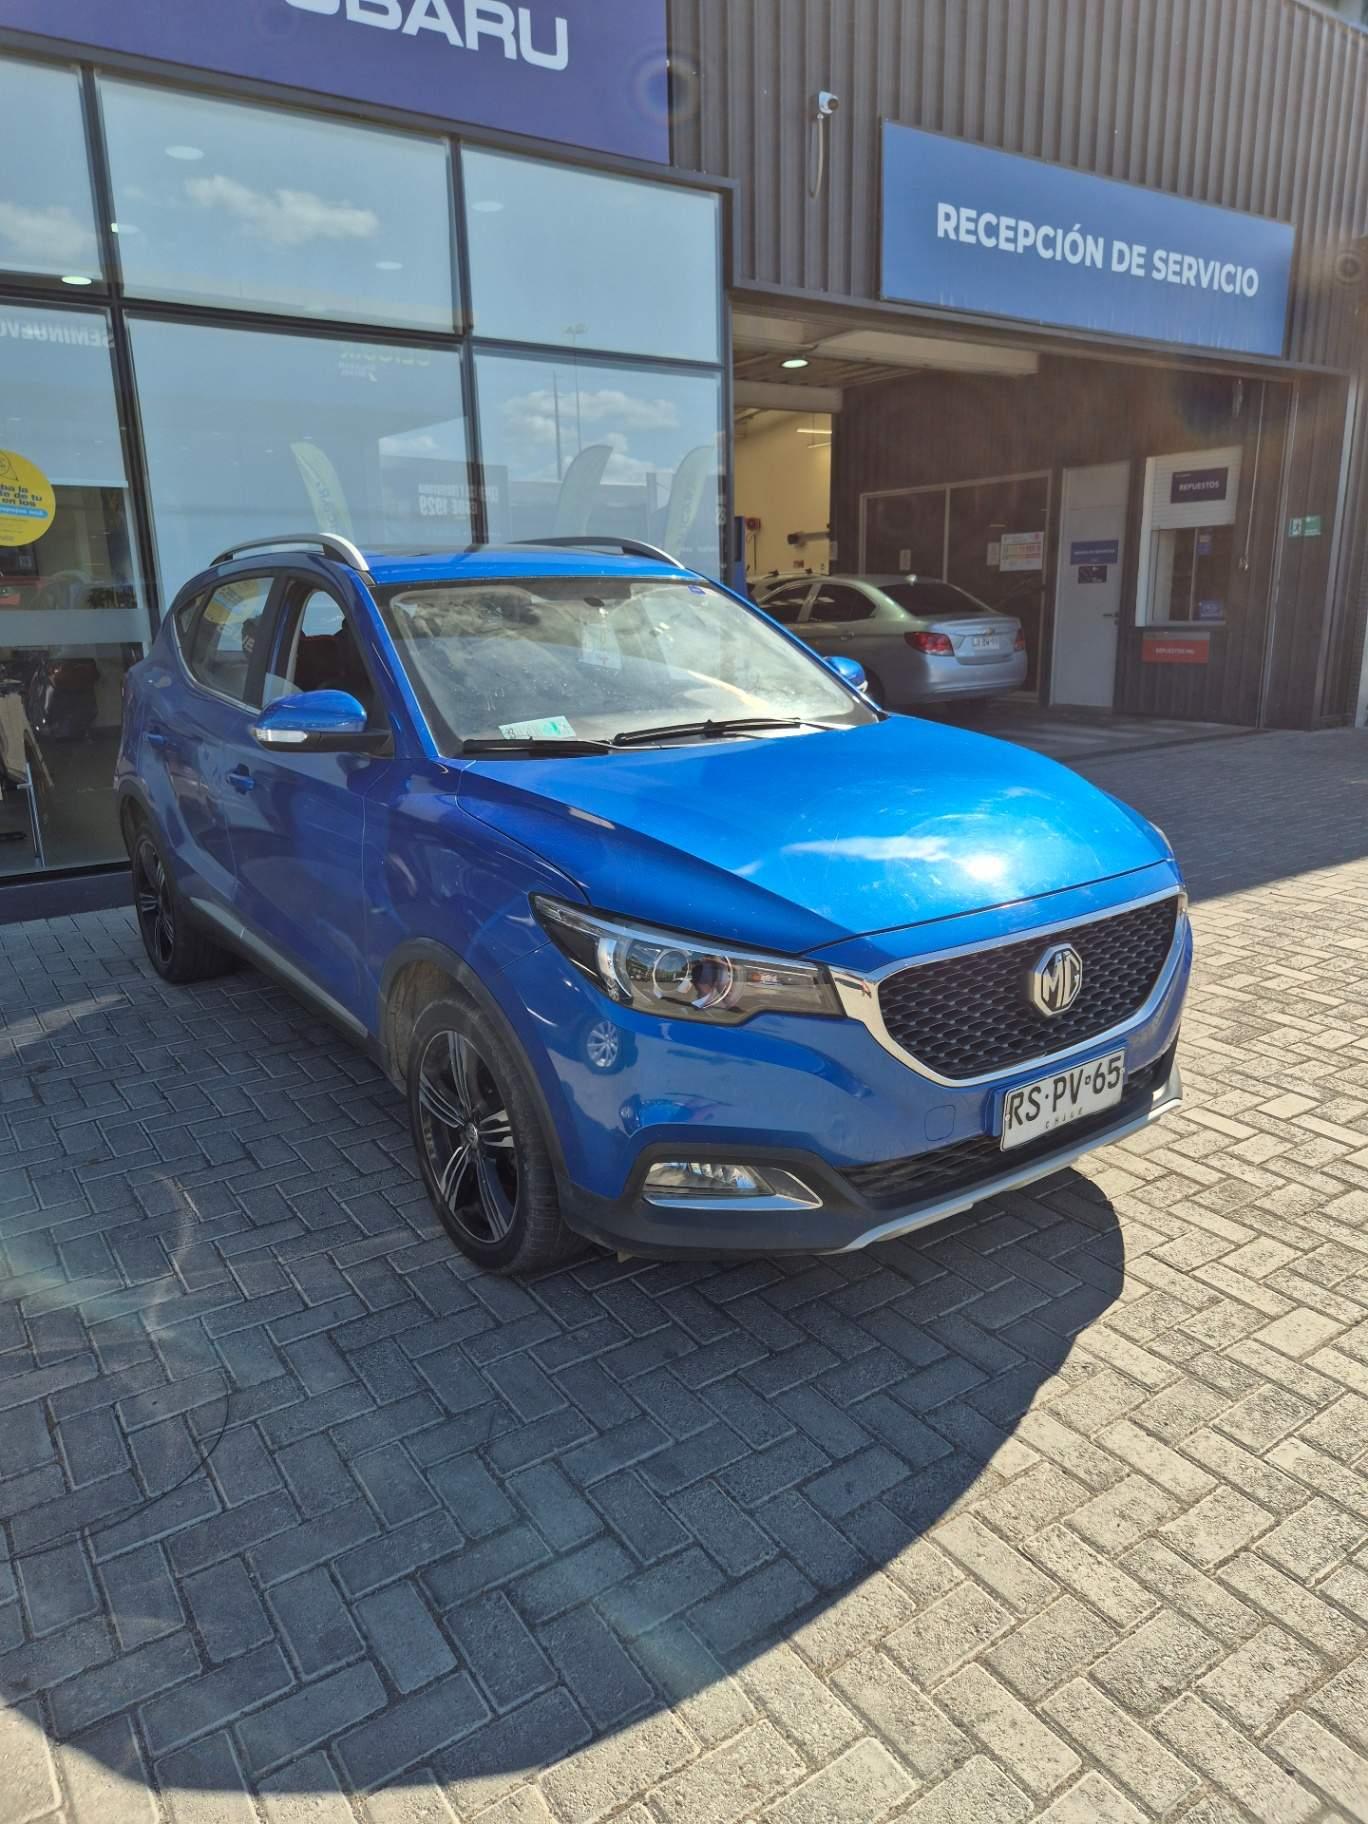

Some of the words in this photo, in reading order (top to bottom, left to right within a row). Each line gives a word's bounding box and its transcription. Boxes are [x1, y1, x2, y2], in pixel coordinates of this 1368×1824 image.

[937, 202, 1104, 269] RECEPCIÓN
[1111, 239, 1147, 277] DE
[1152, 249, 1259, 298] SERVICIO
[1178, 480, 1220, 490] REPUESTOS
[1041, 950, 1080, 1008] MG
